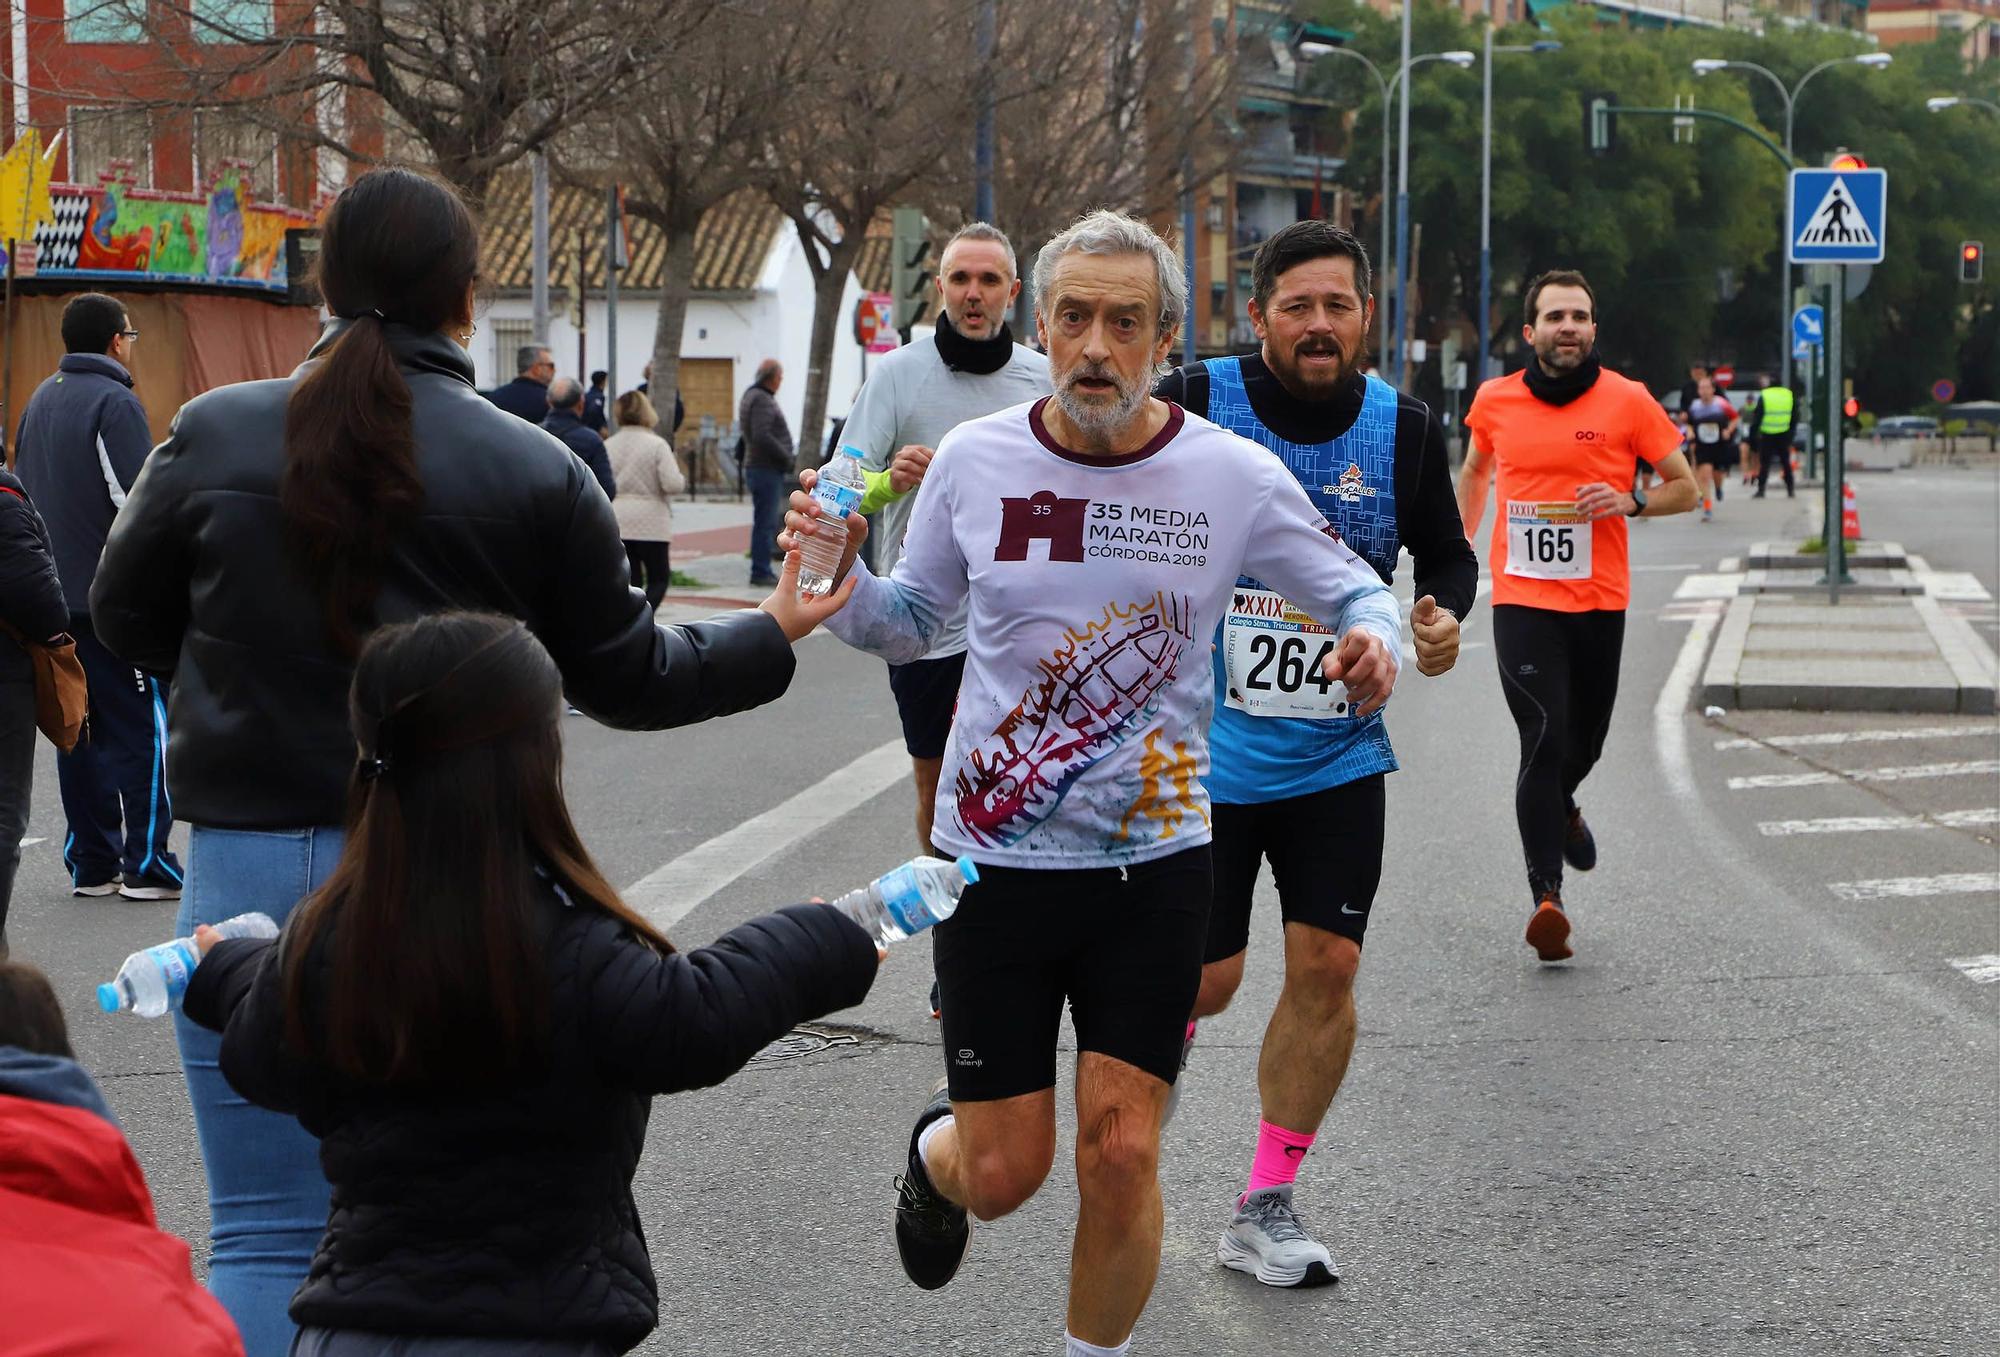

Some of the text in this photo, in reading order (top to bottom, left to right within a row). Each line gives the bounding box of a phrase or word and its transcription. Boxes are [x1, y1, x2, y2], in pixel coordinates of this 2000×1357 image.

[1032, 504, 1052, 516] 35
[1091, 503, 1210, 528] 35 MEDIA
[1089, 524, 1209, 550] MARATÓN
[1524, 528, 1574, 563] 165
[1229, 617, 1253, 627] Colegio
[1273, 621, 1298, 631] Trinidad
[1246, 634, 1335, 695] 264
